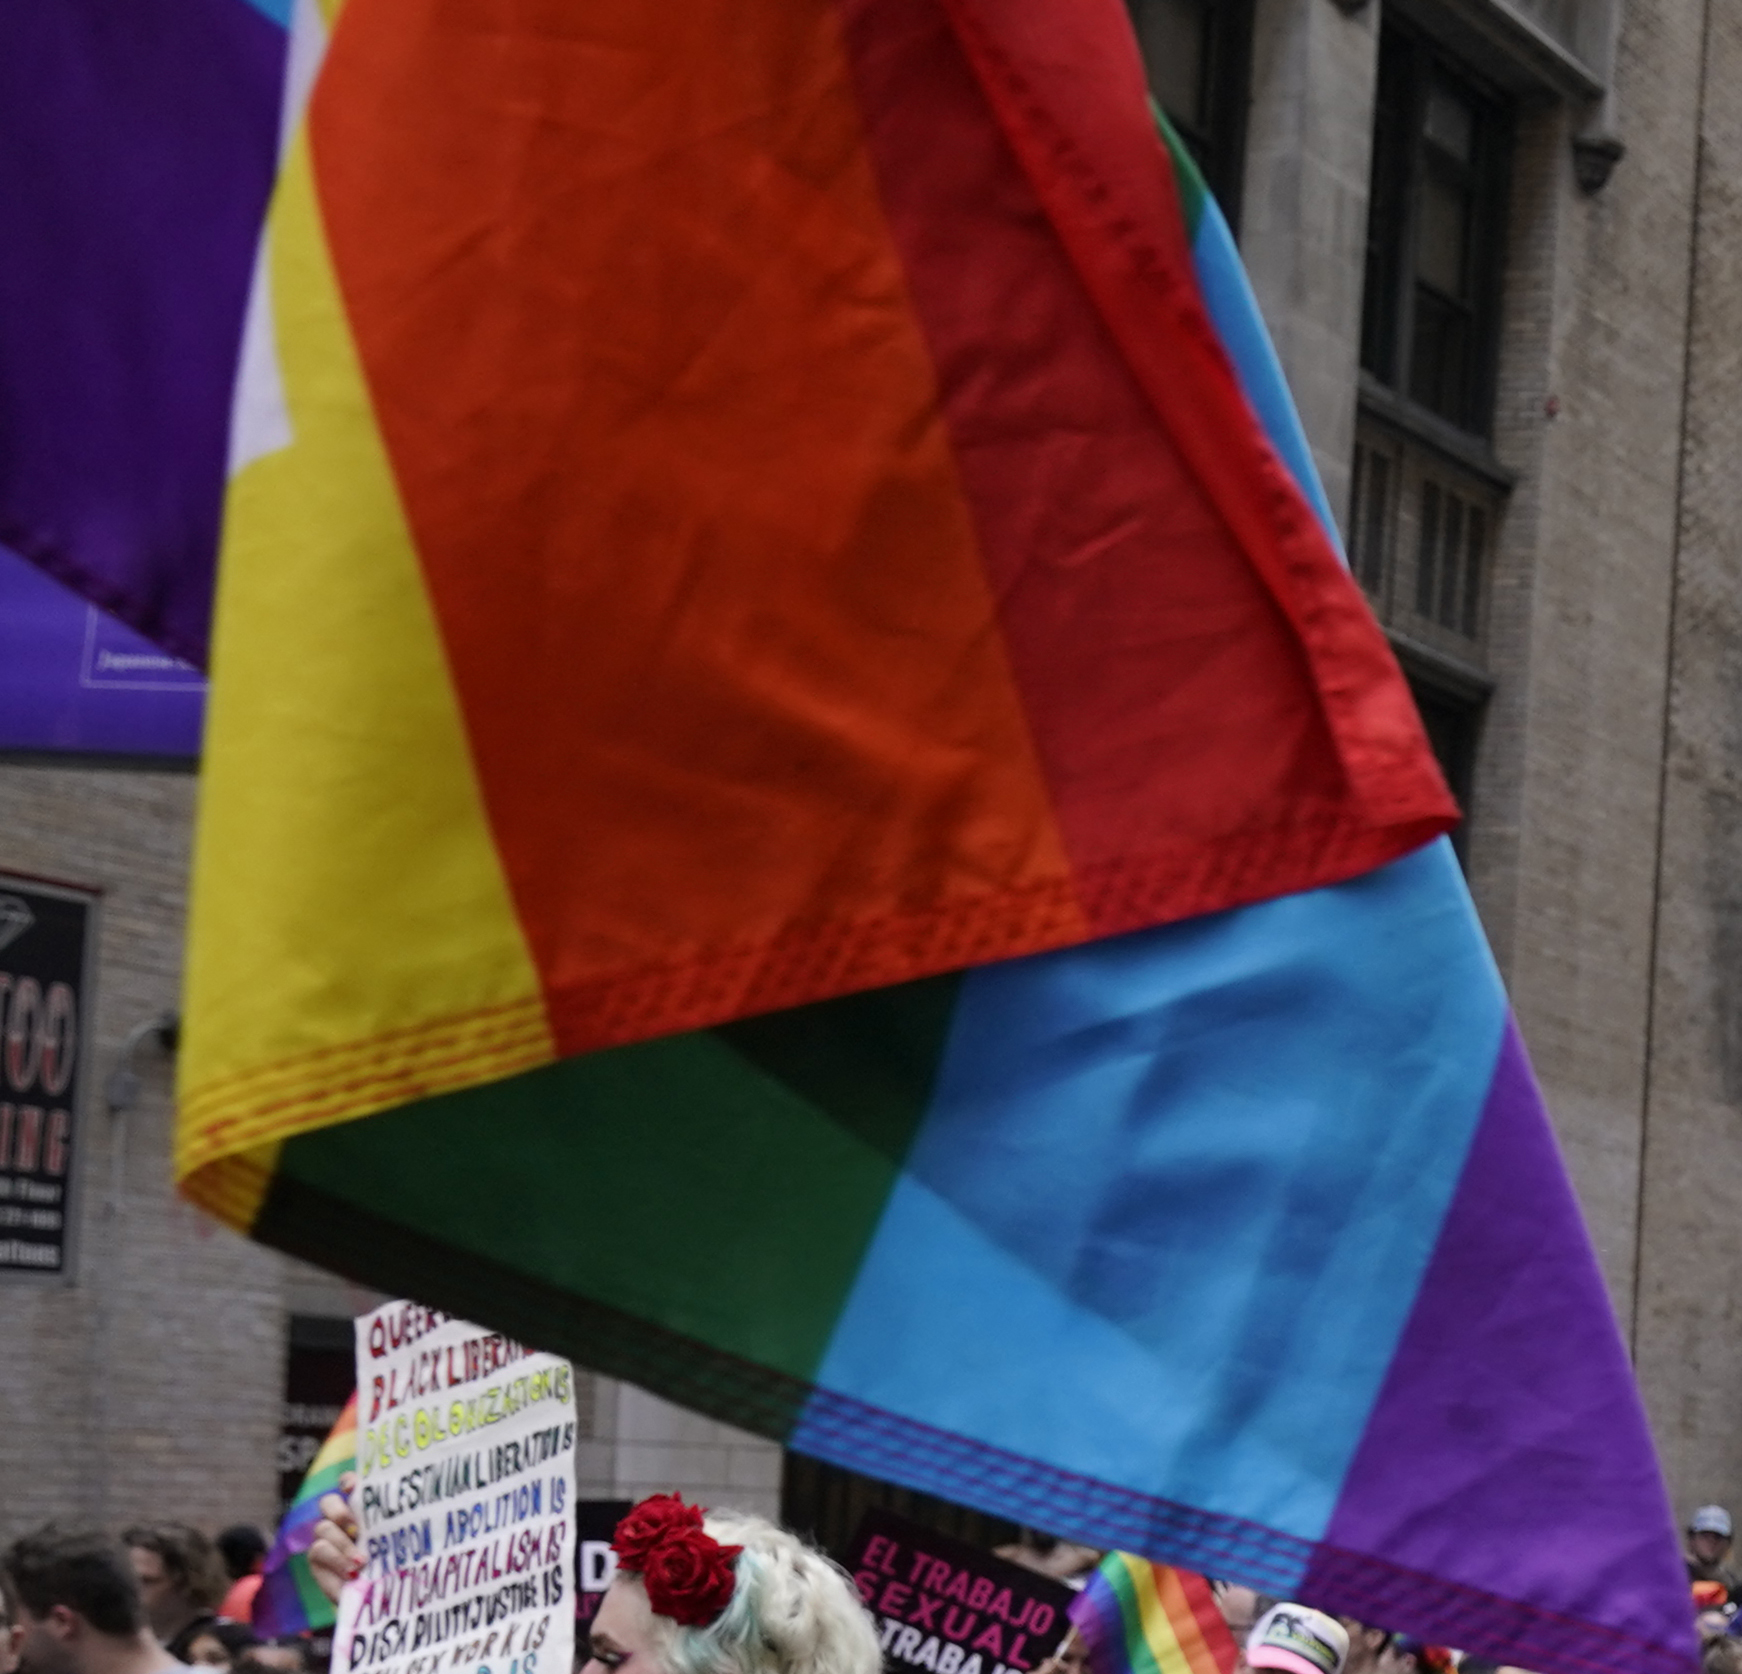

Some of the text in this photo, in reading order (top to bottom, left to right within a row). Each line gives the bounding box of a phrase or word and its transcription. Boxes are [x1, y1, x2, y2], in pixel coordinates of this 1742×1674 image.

[362, 1365, 570, 1477] DECOLONIZATION IS
[370, 1348, 441, 1423] BLACK
[363, 1421, 574, 1529] PALESTINIAN LIBERATION IS
[355, 1520, 566, 1627] ANTICAPITALISM IS
[366, 1476, 566, 1578] PRISON ABOLITION IS
[543, 1565, 563, 1607] IS
[854, 1569, 1031, 1669] SEXUAL
[862, 1534, 899, 1576] EL
[909, 1551, 1055, 1636] TRABAJO
[452, 1622, 521, 1666] WORK
[523, 1615, 551, 1651] IS
